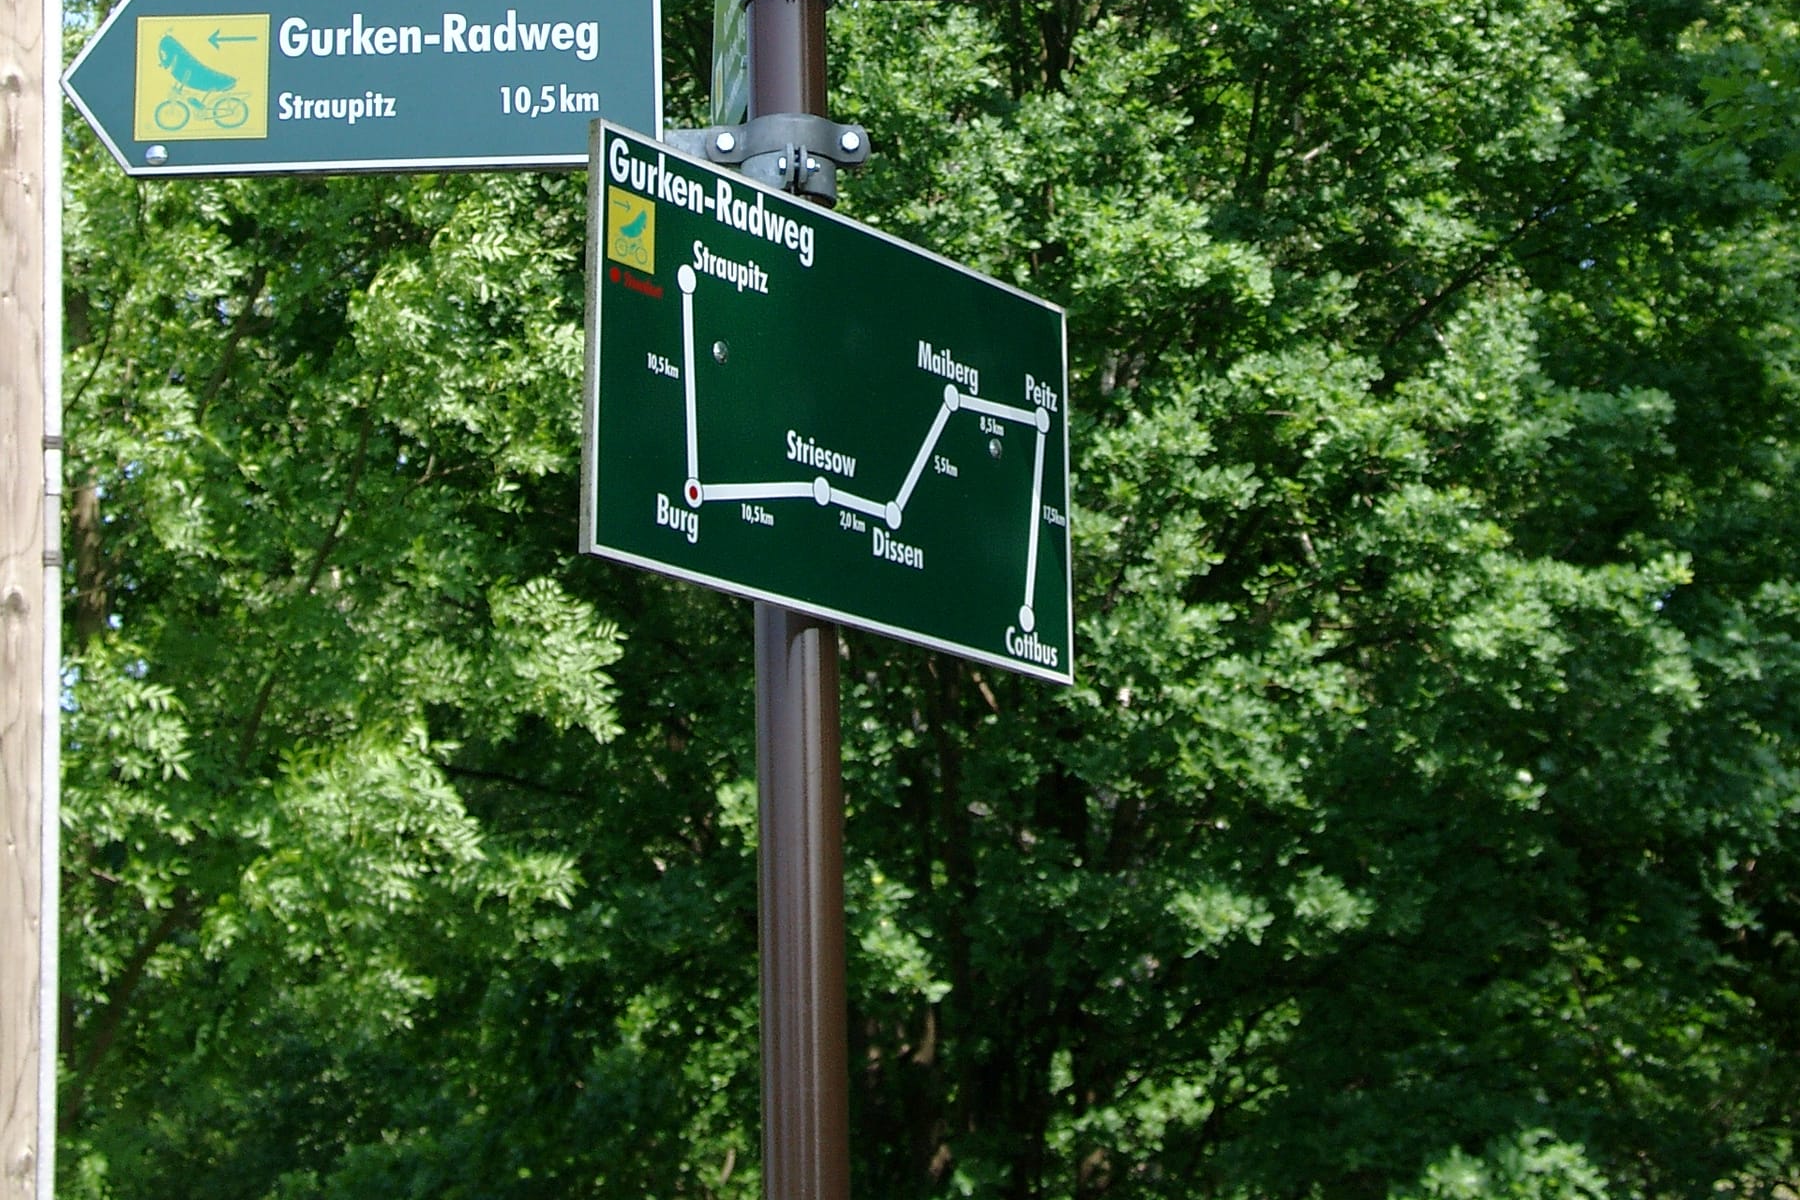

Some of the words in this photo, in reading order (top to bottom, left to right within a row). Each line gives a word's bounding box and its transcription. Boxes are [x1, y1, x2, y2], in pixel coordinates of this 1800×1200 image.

[280, 10, 598, 60] Gurken-Radweg
[279, 92, 396, 124] Straupitz
[609, 138, 815, 267] Gurken-Radweg
[693, 240, 769, 293] Straupitz
[917, 340, 978, 395] Maiberg
[1025, 373, 1057, 412] Peitz
[786, 429, 856, 477] Striesow
[656, 493, 699, 544] Burg
[872, 526, 924, 569] Dissen
[1005, 625, 1058, 667] Cottbus
